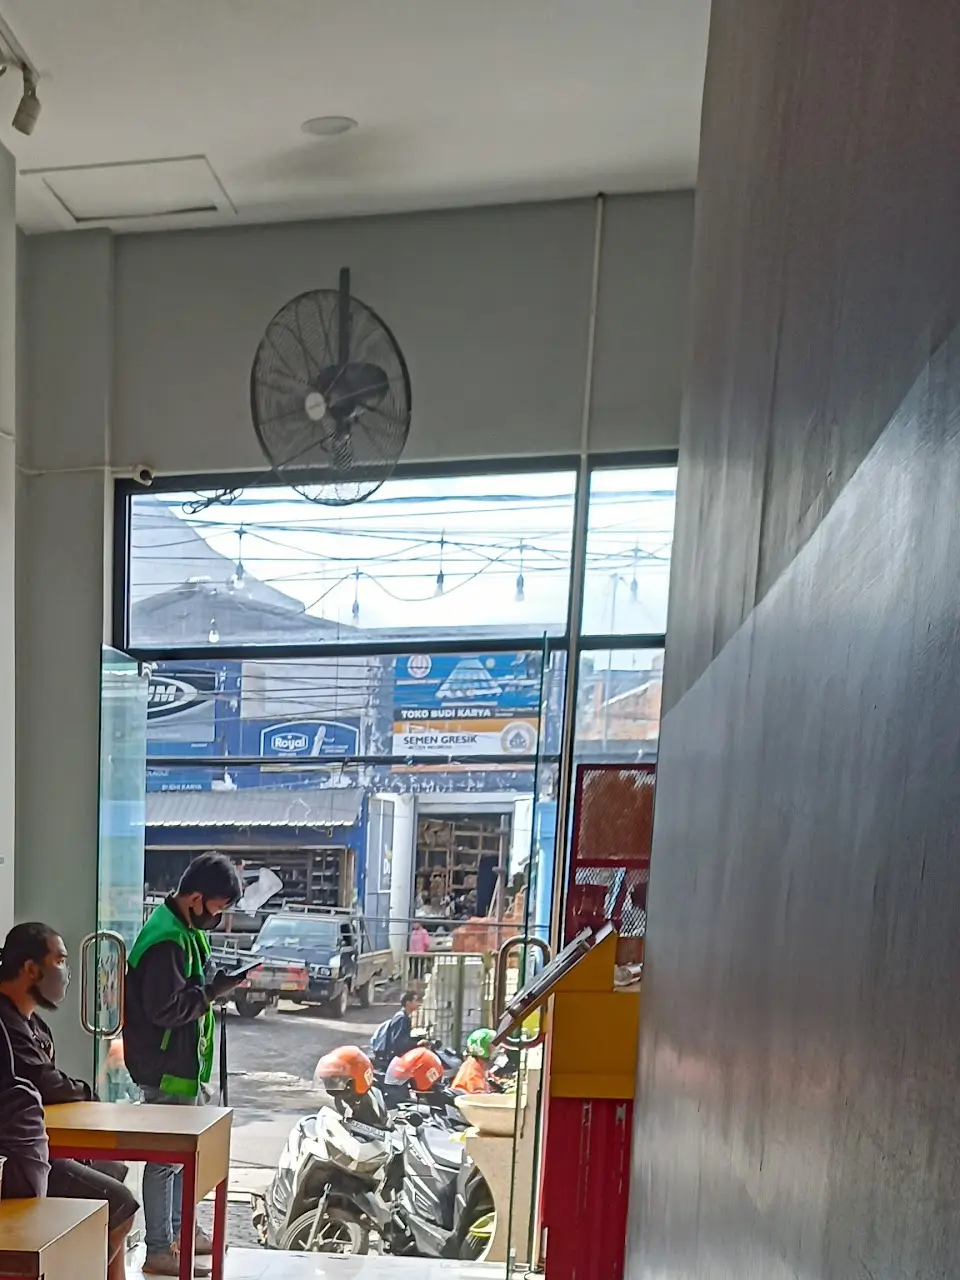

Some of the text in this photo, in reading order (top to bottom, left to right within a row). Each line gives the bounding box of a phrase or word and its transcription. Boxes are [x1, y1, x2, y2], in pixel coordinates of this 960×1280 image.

[400, 710, 428, 719] TOKO
[430, 709, 455, 718] BUDI
[457, 708, 492, 717] KARYA
[276, 736, 305, 750] Royal
[403, 734, 479, 745] SEMEN GRESIK
